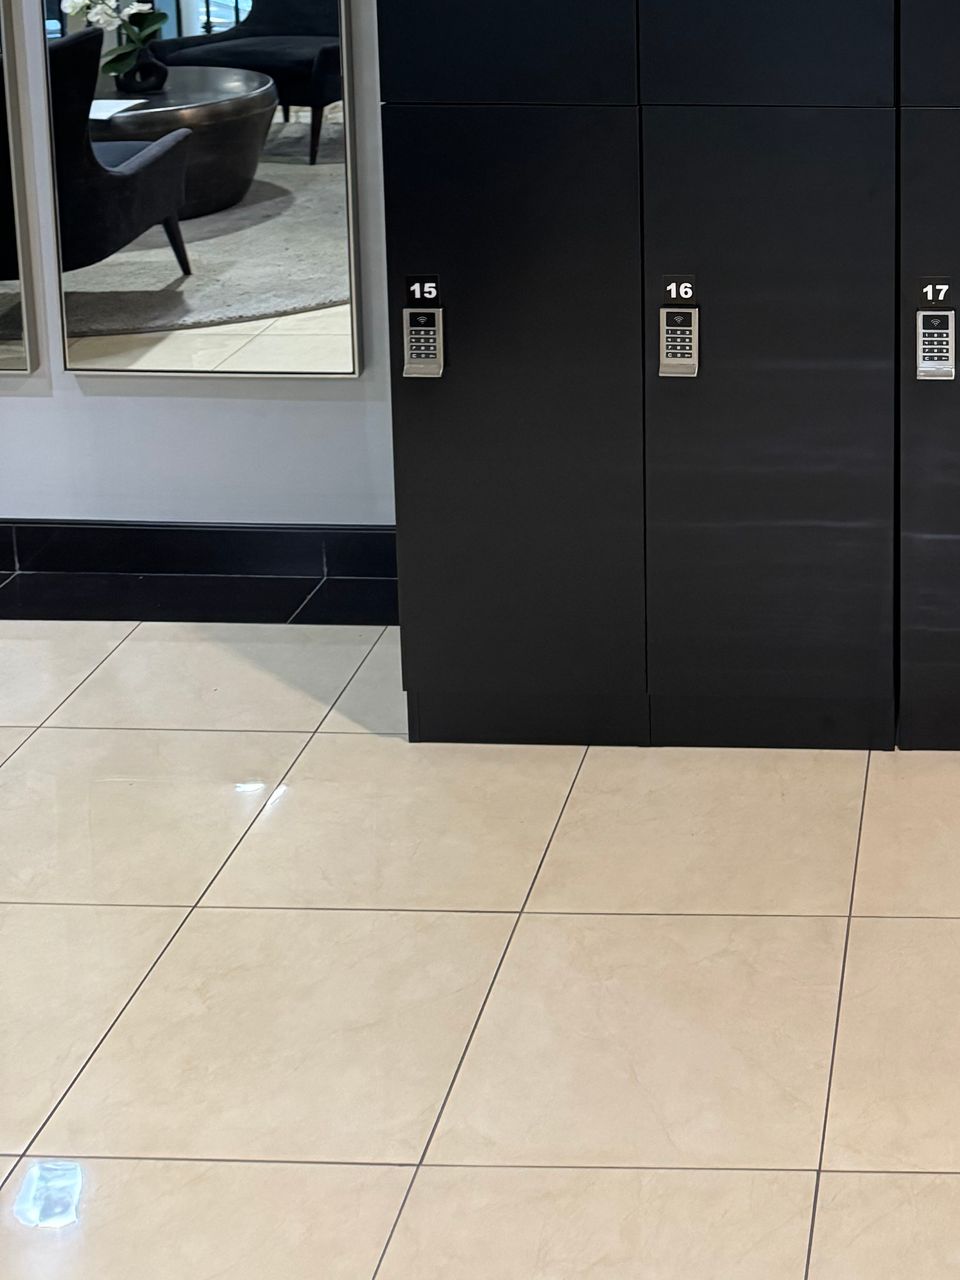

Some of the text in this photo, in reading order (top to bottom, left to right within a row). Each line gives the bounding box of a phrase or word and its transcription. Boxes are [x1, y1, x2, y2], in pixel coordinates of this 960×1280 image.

[410, 283, 437, 298] 15
[666, 283, 693, 298] 16
[923, 285, 949, 300] 17
